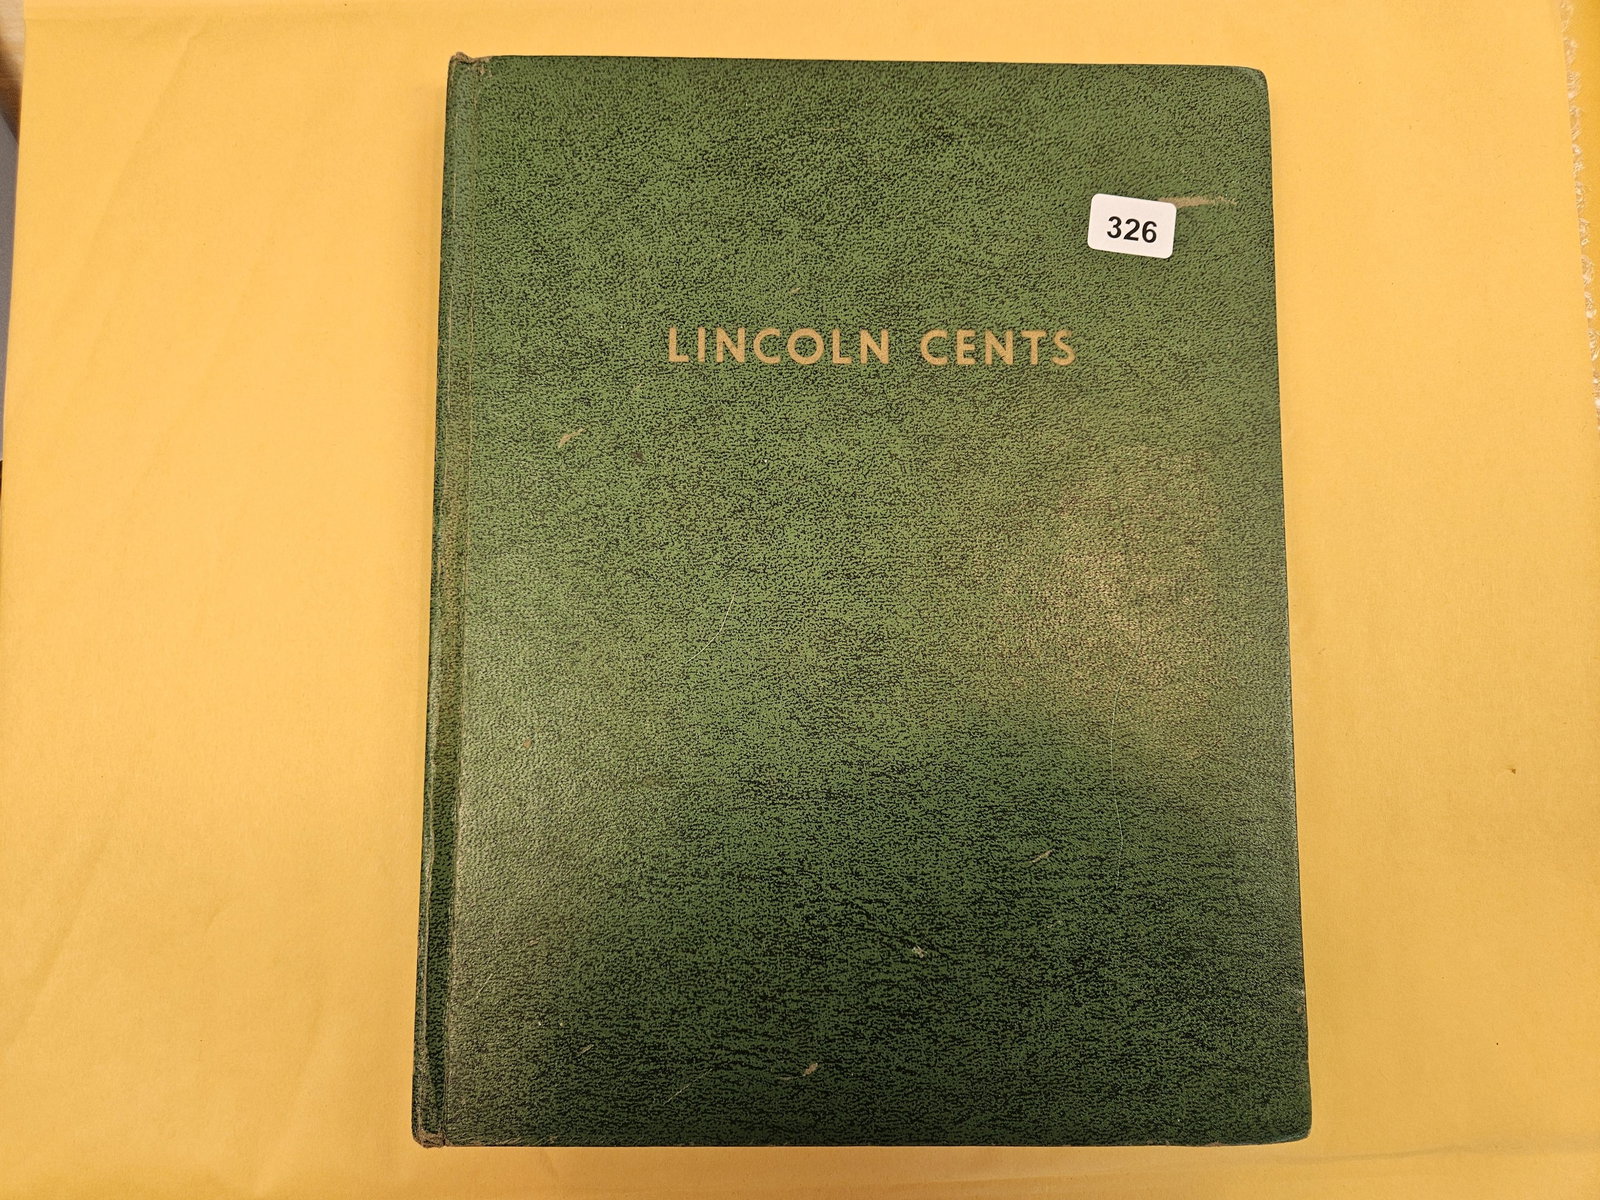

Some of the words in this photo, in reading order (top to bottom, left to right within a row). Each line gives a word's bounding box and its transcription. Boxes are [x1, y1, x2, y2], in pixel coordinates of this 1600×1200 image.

[1106, 215, 1158, 244] 326
[667, 325, 891, 366] LINCOLN
[918, 327, 1078, 369] CENTS
